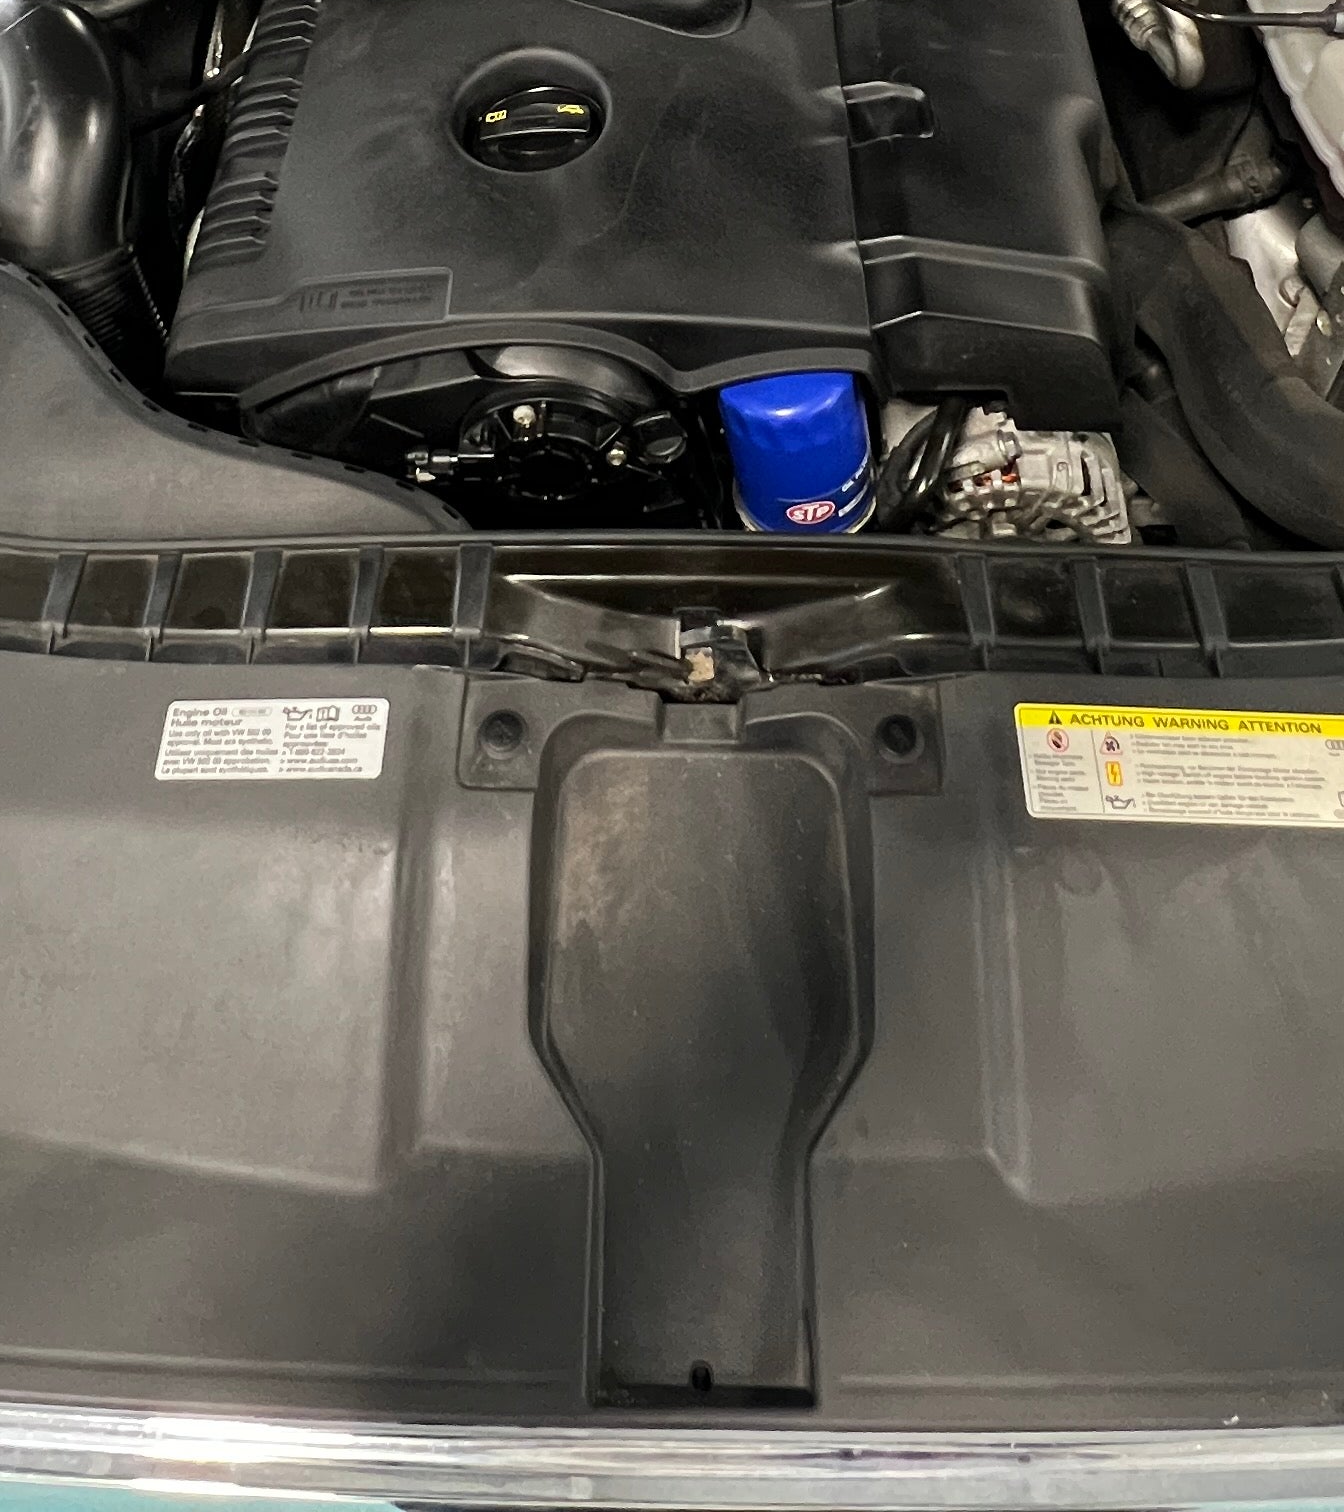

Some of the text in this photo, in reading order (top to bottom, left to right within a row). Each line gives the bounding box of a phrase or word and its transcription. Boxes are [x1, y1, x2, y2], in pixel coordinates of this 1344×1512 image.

[792, 503, 830, 521] STP
[173, 708, 210, 719] Engine
[213, 707, 228, 717] Oil
[201, 719, 243, 727] moteur
[1069, 713, 1322, 735] ACHTUNG WARNING ATTENTION
